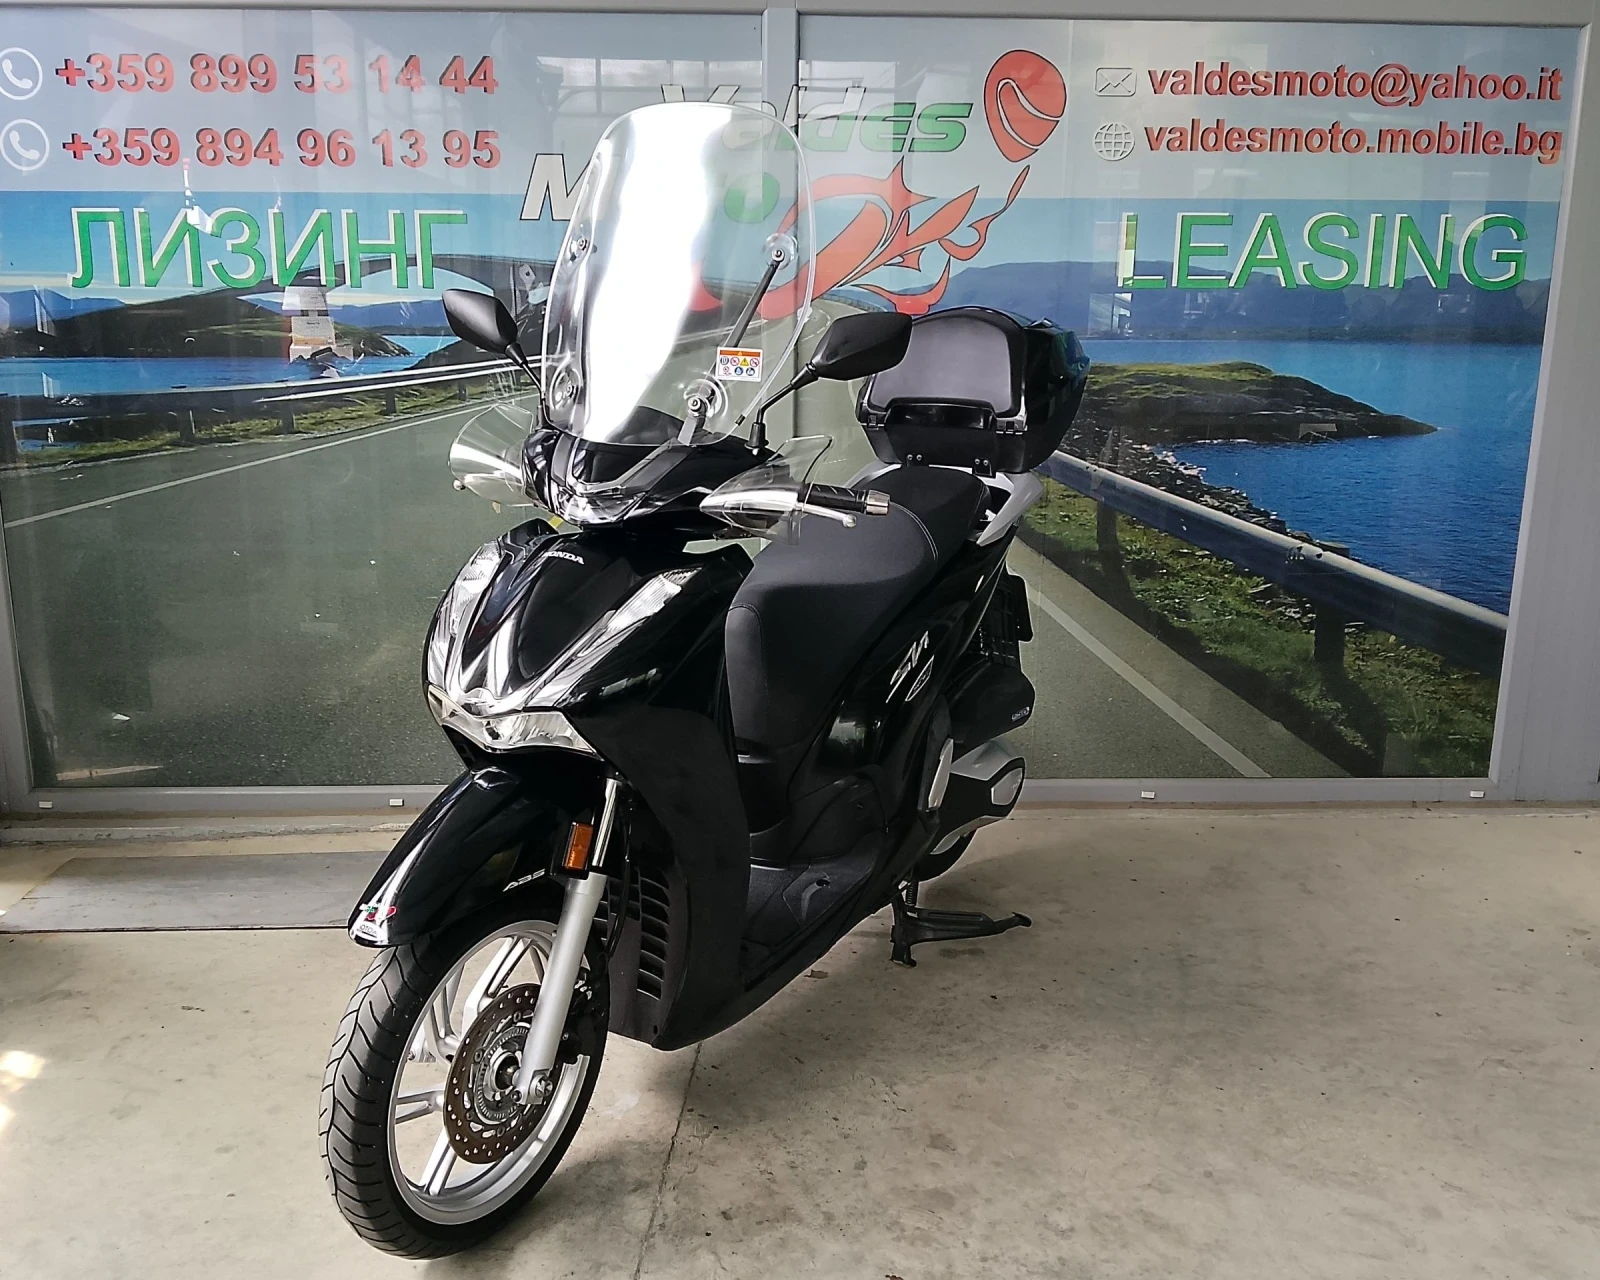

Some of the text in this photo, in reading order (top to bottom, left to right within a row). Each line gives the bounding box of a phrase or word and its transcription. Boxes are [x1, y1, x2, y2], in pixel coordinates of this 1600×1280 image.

[55, 53, 499, 95] +359 899 53 14 44
[1147, 61, 1563, 107] valdesmoto@yahoo.it
[661, 84, 974, 153] aldes
[1144, 118, 1563, 164] valdesmoto.mobile.bg
[62, 127, 502, 169] +359 894 96 13 95
[66, 207, 469, 289] ЛИЗИНГ
[1117, 212, 1529, 291] LEASING
